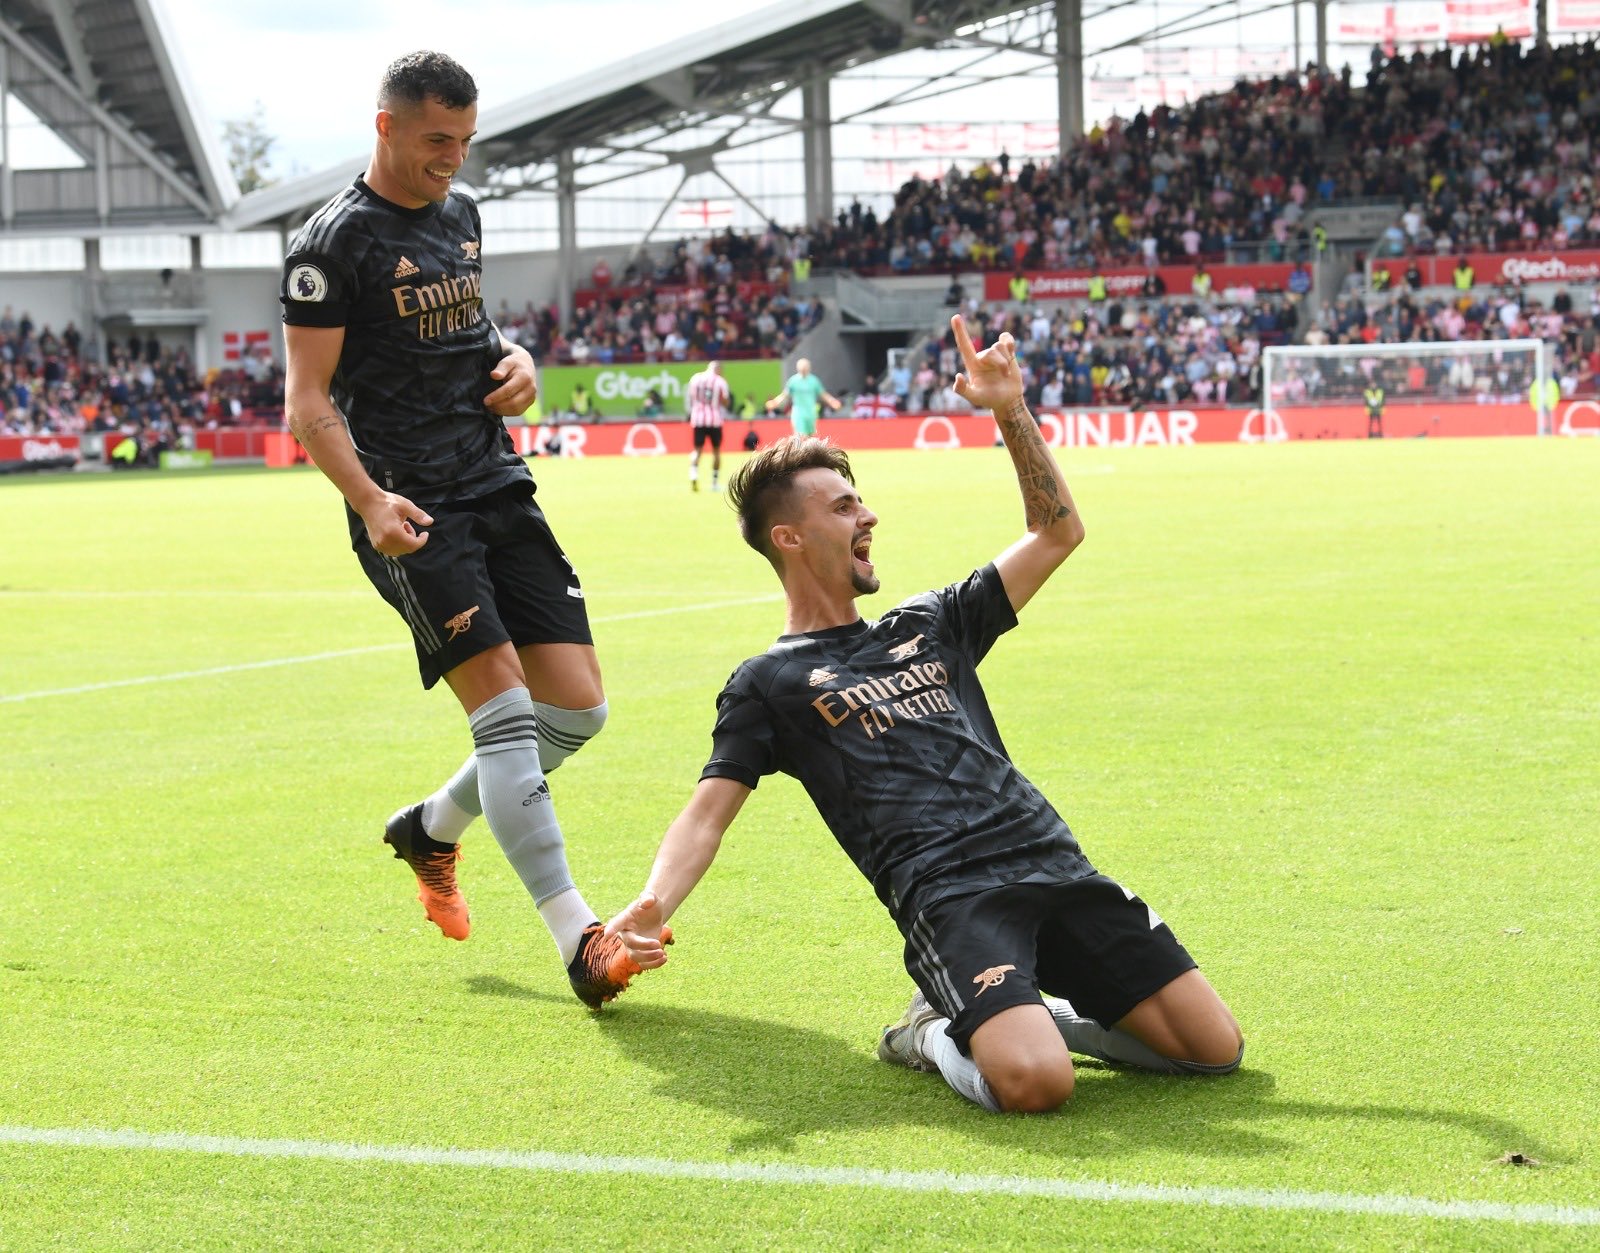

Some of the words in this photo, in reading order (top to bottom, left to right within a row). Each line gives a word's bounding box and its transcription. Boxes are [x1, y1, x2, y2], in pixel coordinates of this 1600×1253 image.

[394, 266, 420, 279] adidas
[420, 310, 443, 340] FLY
[993, 410, 1198, 450] OINJAR
[811, 661, 948, 728] Emirates
[859, 705, 895, 740] FLY
[892, 689, 956, 720] BETTER
